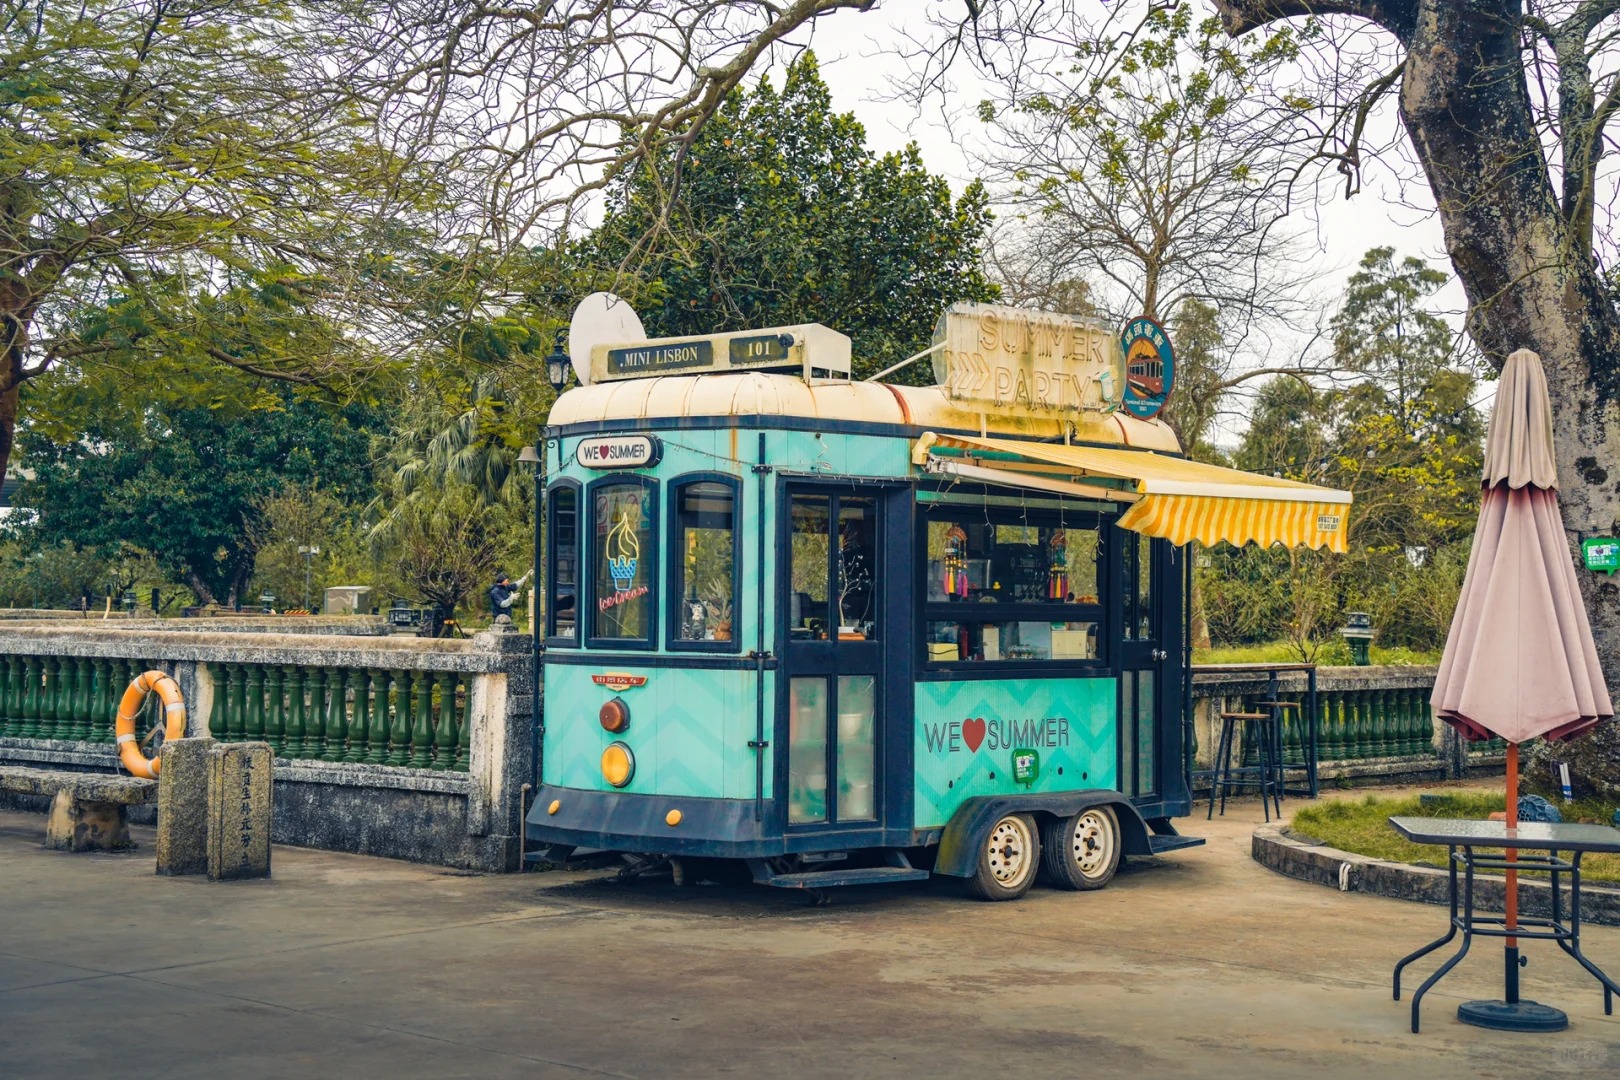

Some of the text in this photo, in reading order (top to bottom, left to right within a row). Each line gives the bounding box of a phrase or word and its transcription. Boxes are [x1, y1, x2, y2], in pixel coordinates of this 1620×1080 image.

[748, 341, 770, 357] 101
[979, 309, 1104, 363] SUMMER
[624, 346, 698, 368] MINI LISBON
[994, 366, 1091, 414] PARTY
[584, 443, 645, 460] WE SUMMER
[924, 718, 1070, 753] WE SUMMER
